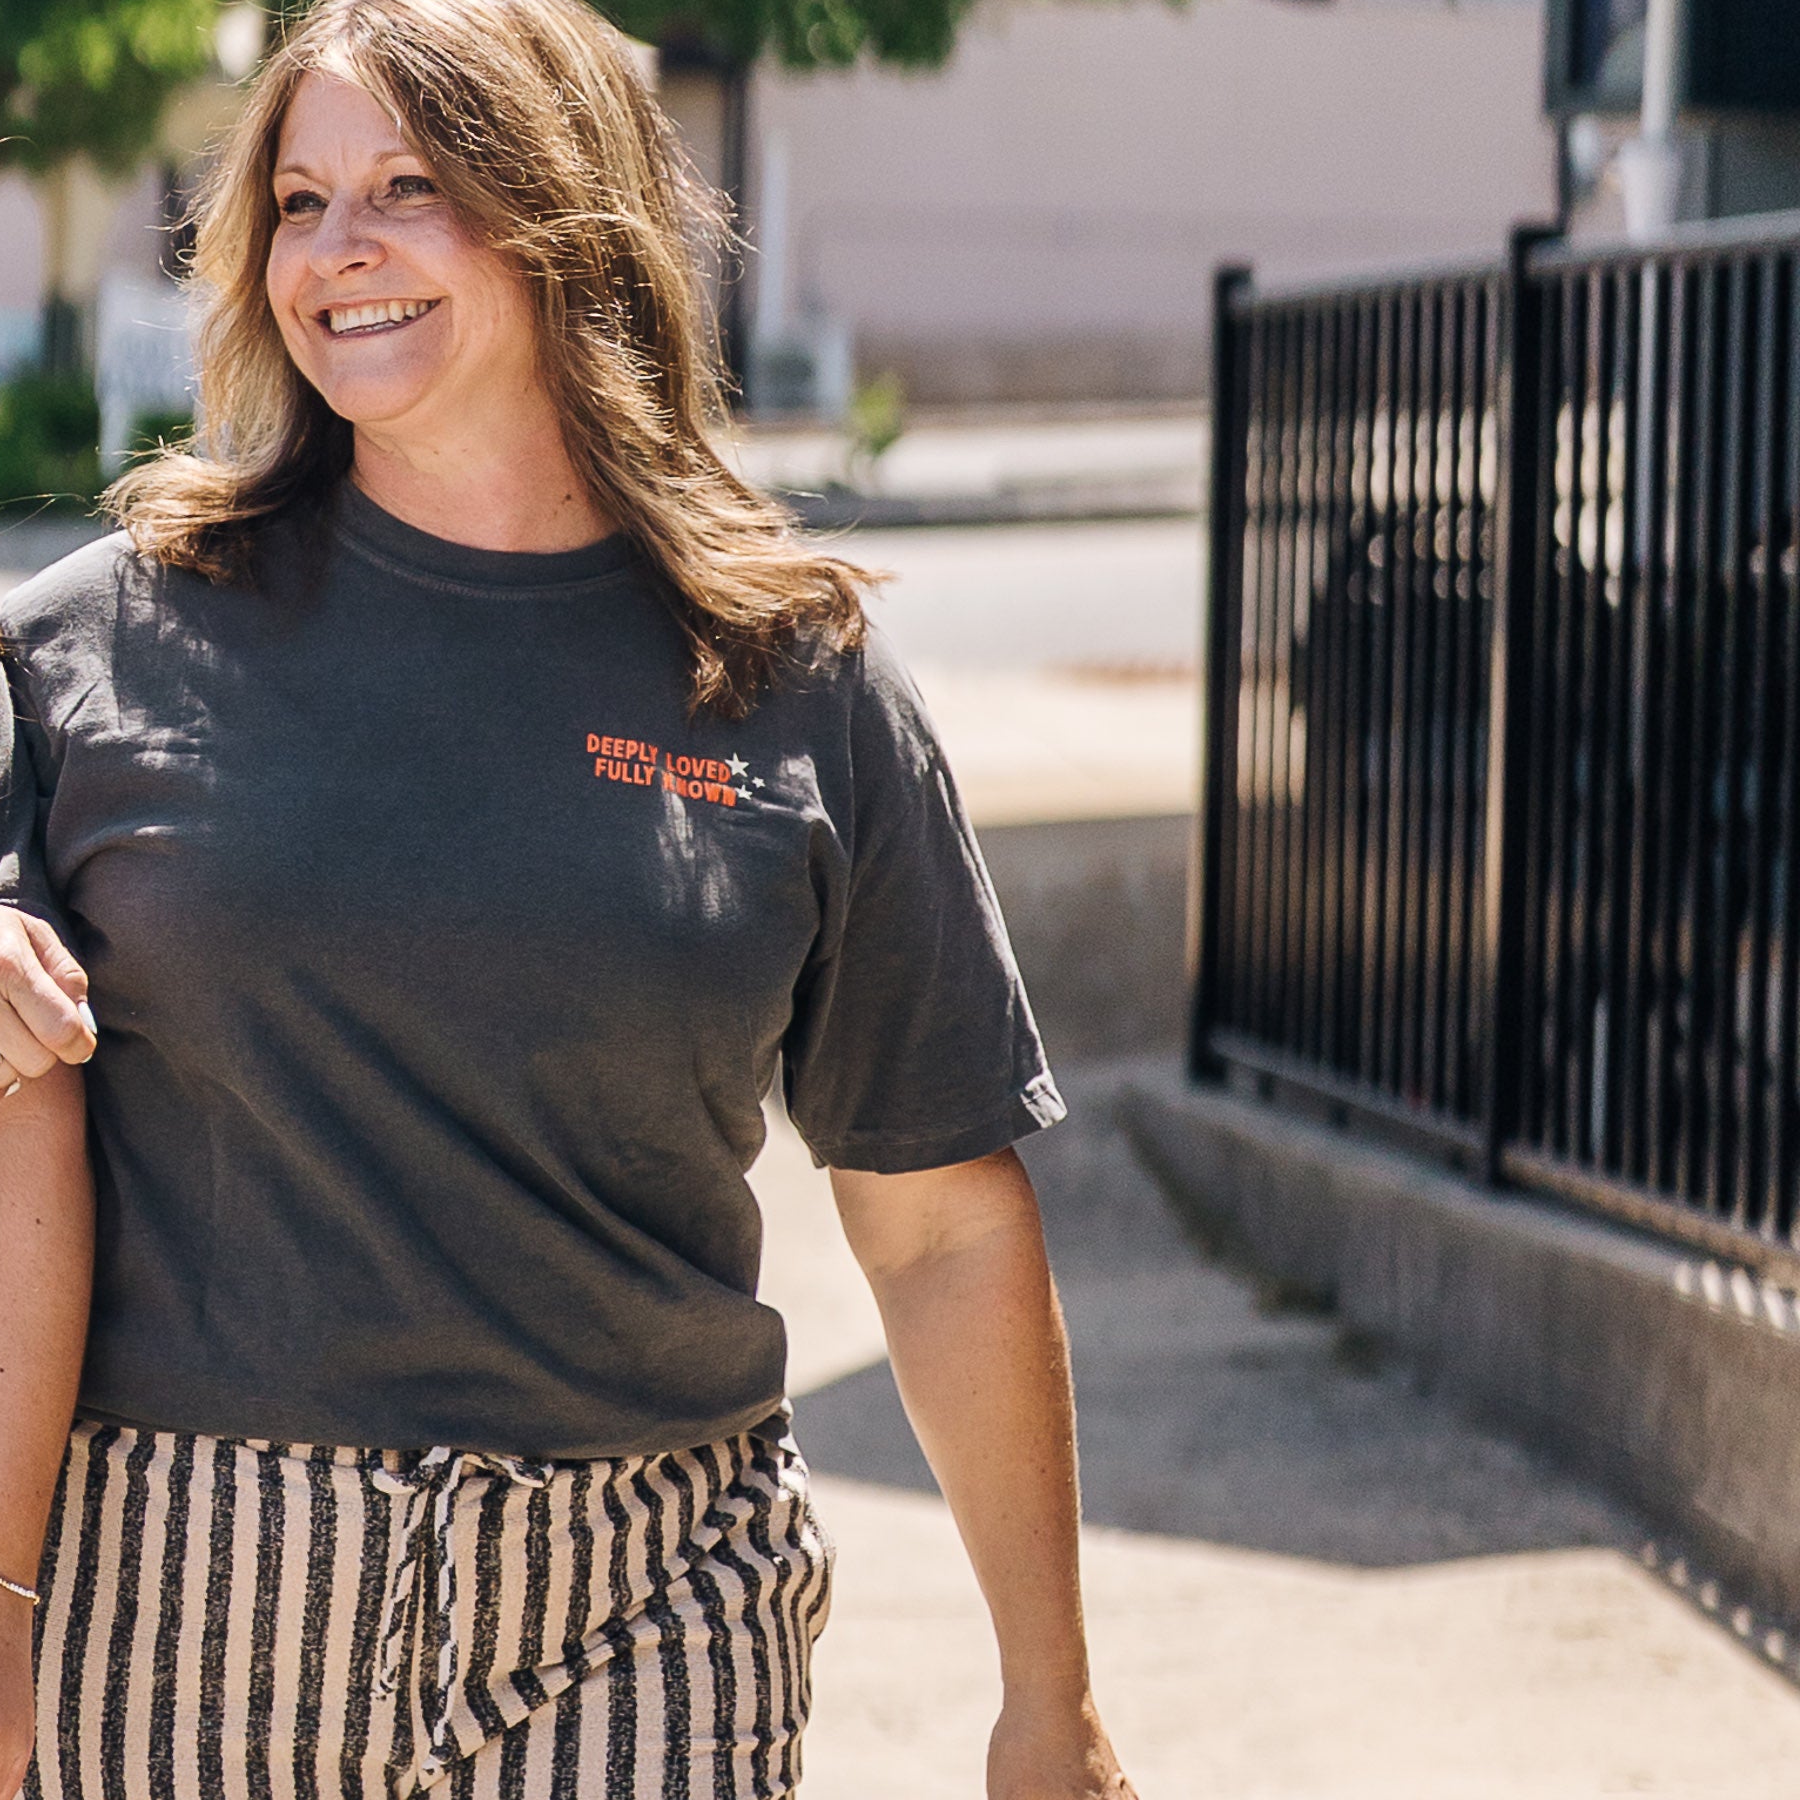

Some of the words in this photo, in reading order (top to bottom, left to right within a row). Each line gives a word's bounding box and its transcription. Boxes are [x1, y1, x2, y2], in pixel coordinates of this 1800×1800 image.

[586, 733, 659, 765] DEEPLY
[665, 752, 731, 784] LOVED
[594, 757, 656, 786] FULLY
[662, 771, 737, 807] KNOWN
